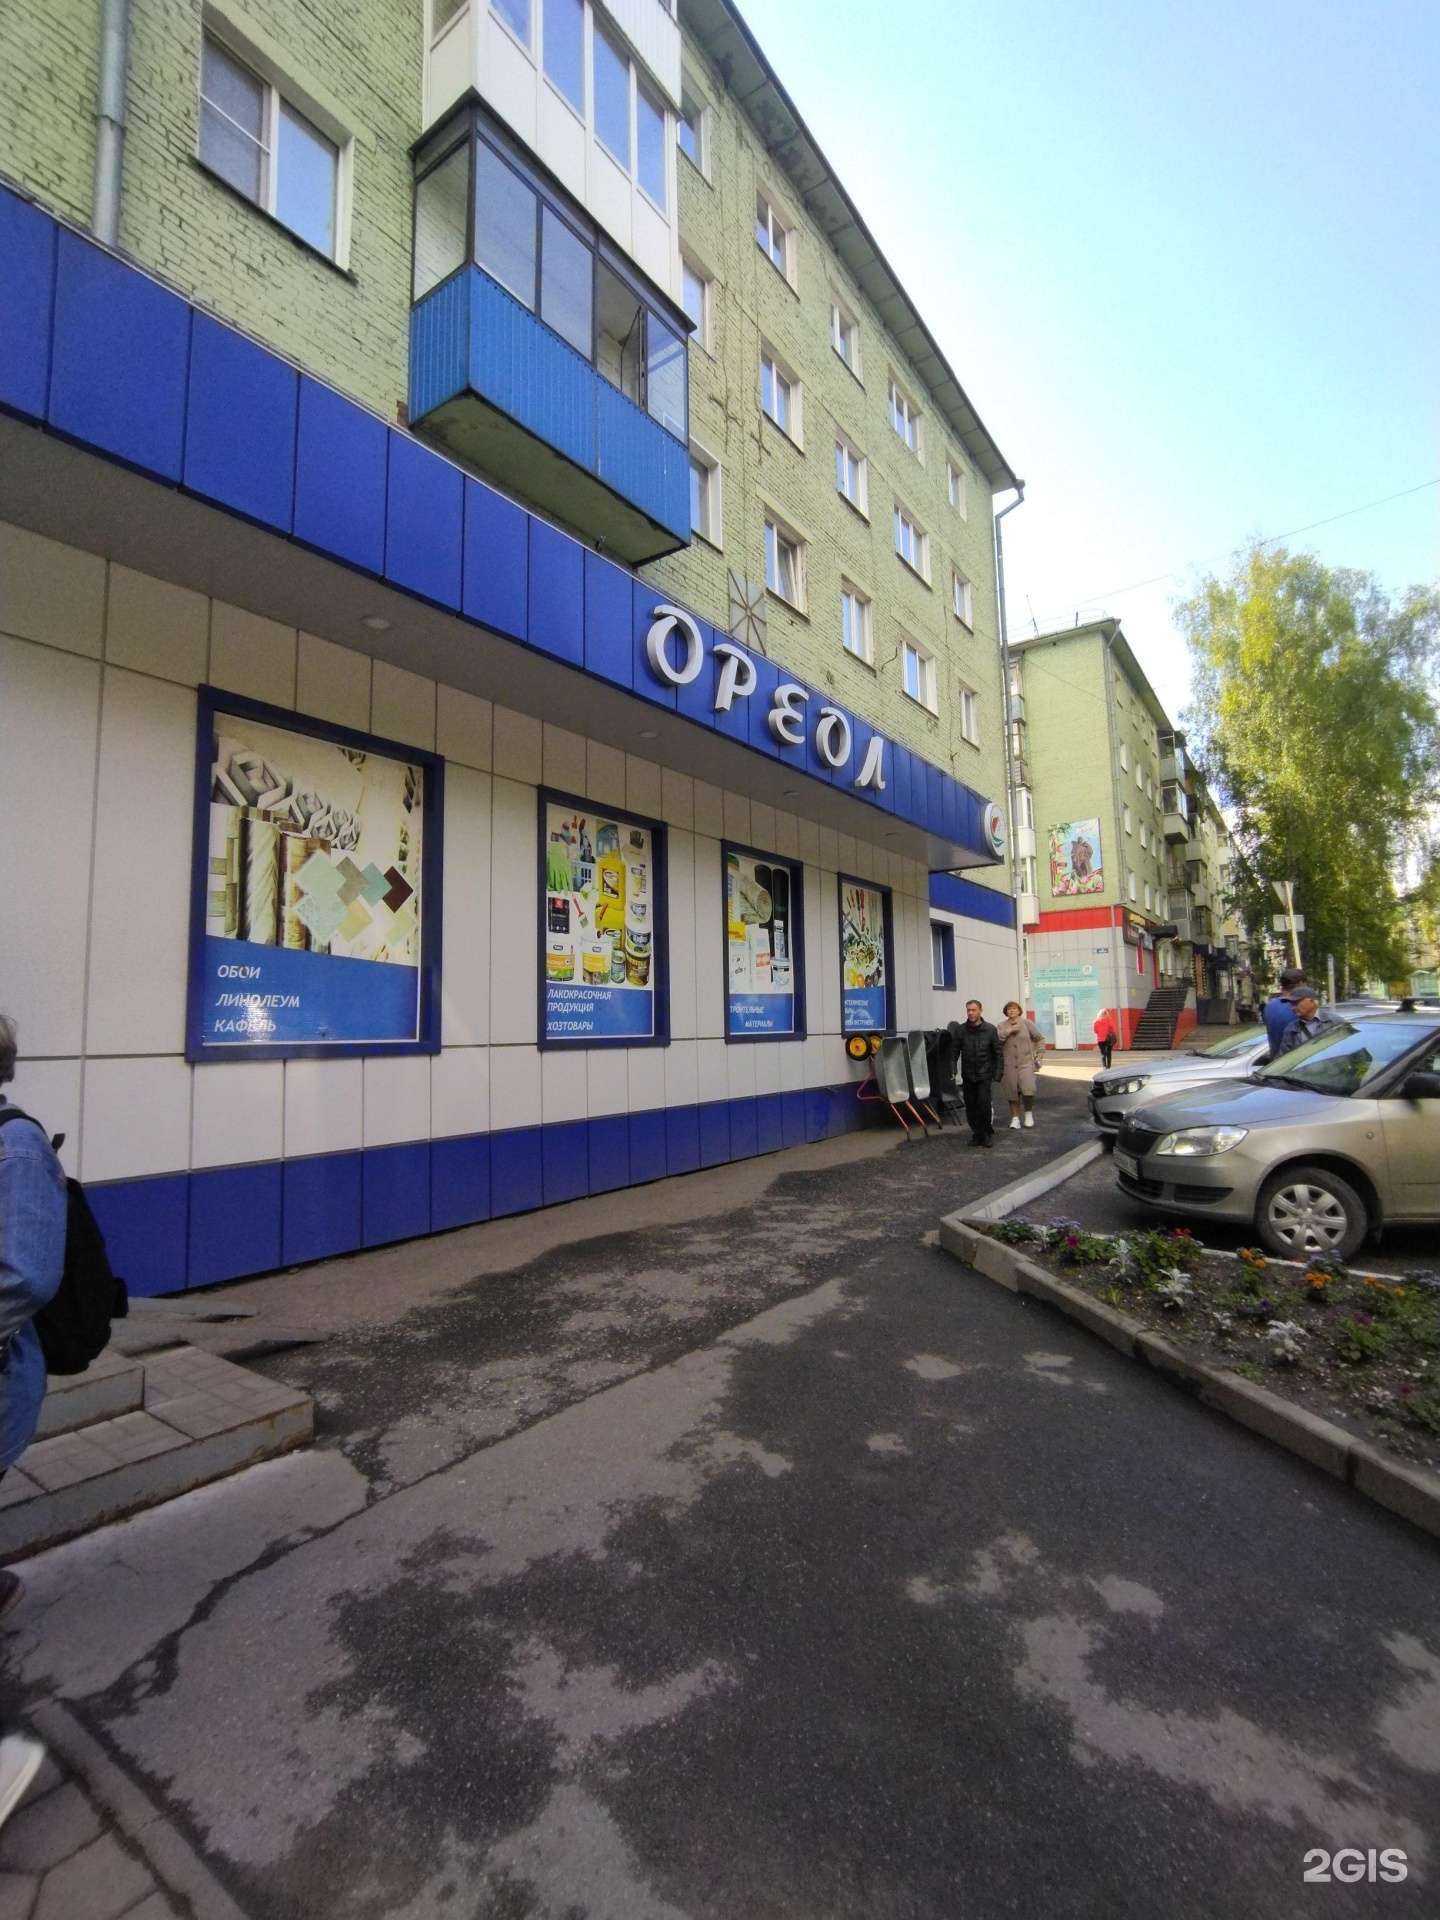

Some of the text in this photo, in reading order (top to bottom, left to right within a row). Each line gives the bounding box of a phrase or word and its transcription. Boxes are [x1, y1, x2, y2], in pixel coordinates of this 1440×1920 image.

[646, 604, 887, 792] ОРЕОЛ
[217, 965, 261, 979] ОБОИ
[216, 993, 300, 1008] ЛИНОЛЕУМ
[547, 989, 612, 1000] ЛАКОКРАСОЧНАЯ
[547, 1002, 594, 1013] ПРОДУКЦИЯ
[214, 1018, 277, 1032] КАФЕЛЬ
[546, 1020, 594, 1031] ХОЗТОВАРЫ
